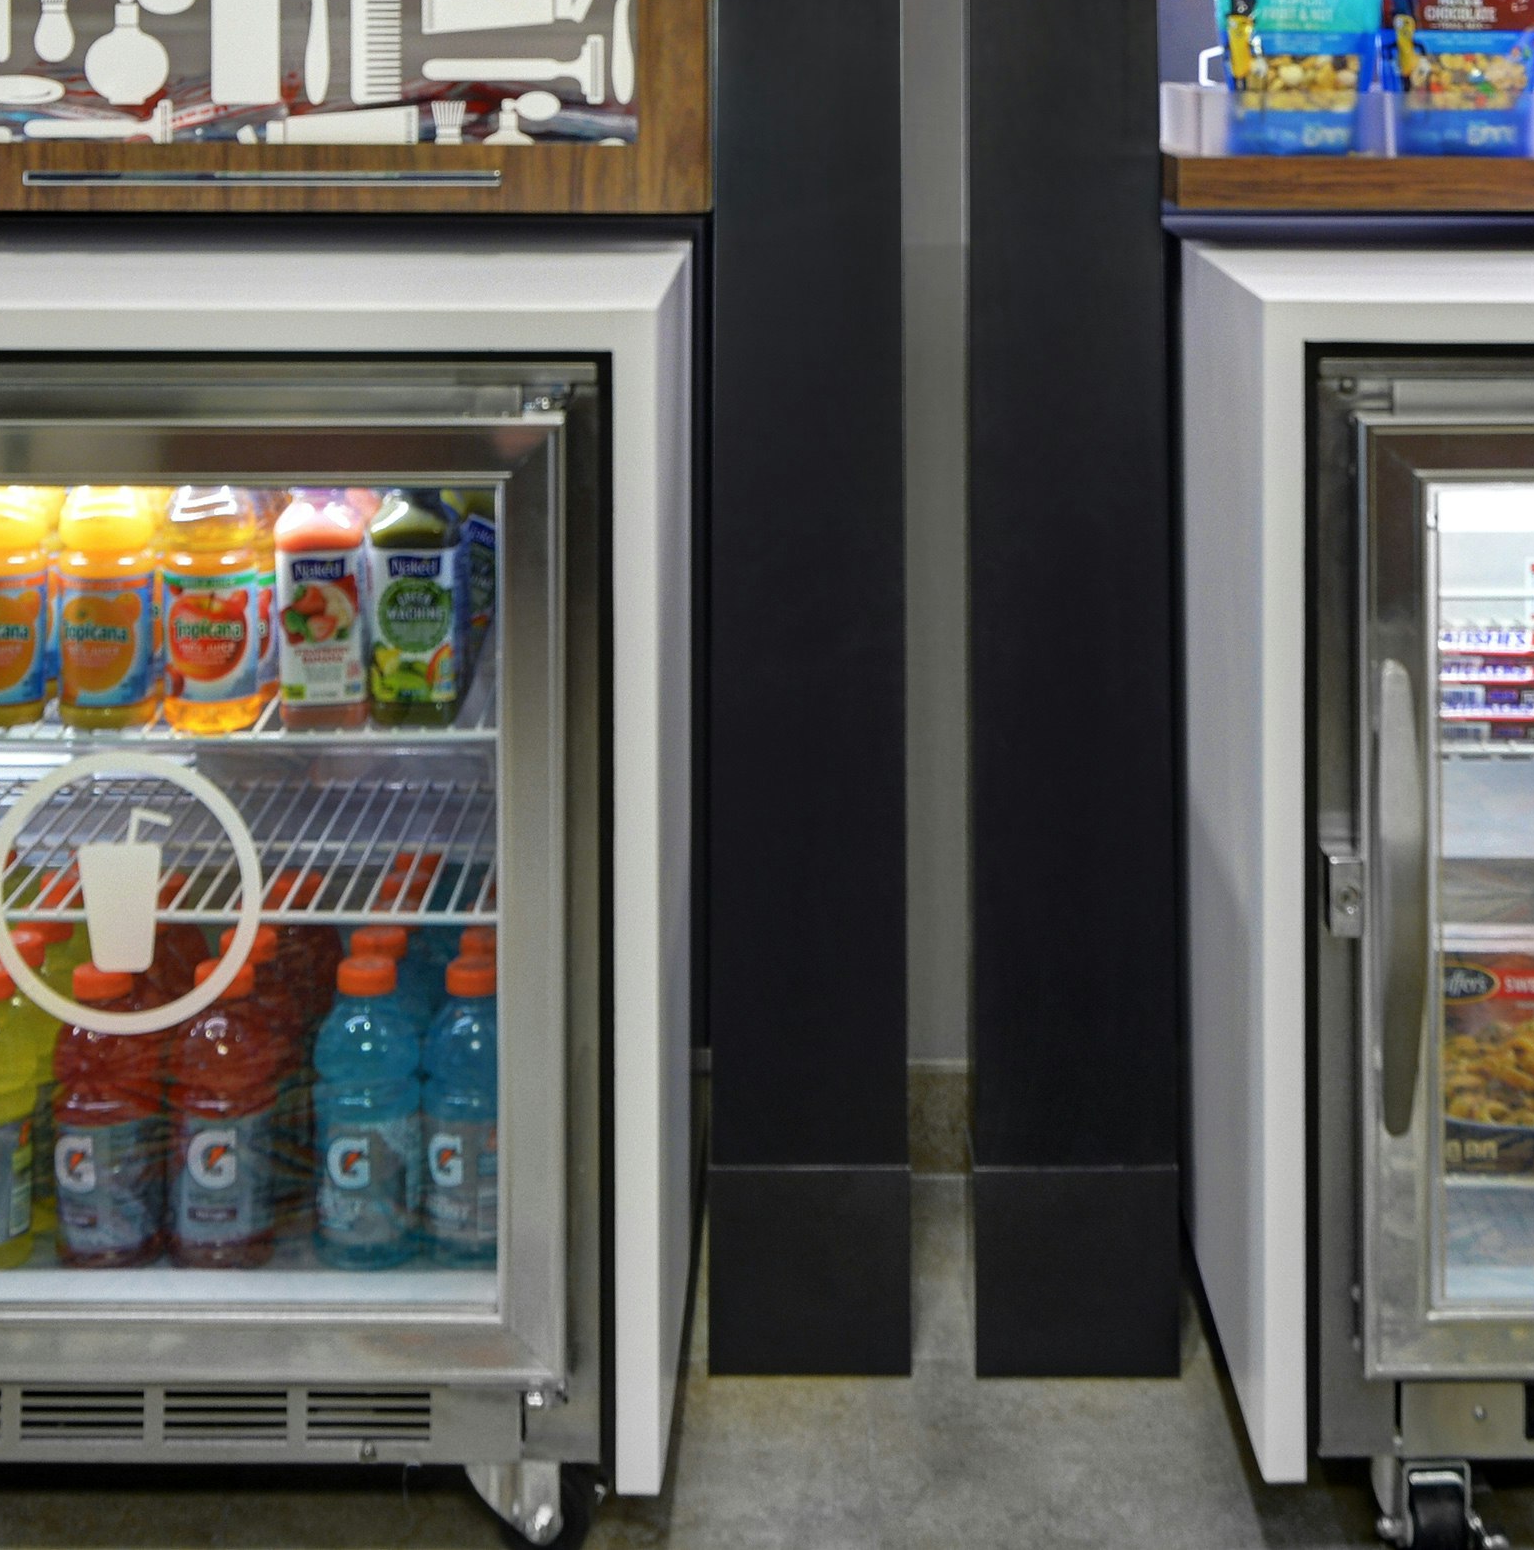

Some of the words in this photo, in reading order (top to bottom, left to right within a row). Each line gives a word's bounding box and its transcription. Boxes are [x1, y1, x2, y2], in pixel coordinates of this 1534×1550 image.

[295, 559, 344, 579] Naked
[390, 556, 440, 577] Naked
[175, 620, 243, 641] Tropicana
[387, 606, 447, 621] MACHINE
[54, 1136, 97, 1194] G
[187, 1129, 237, 1190] G
[326, 1136, 372, 1190] G
[428, 1132, 464, 1188] G
